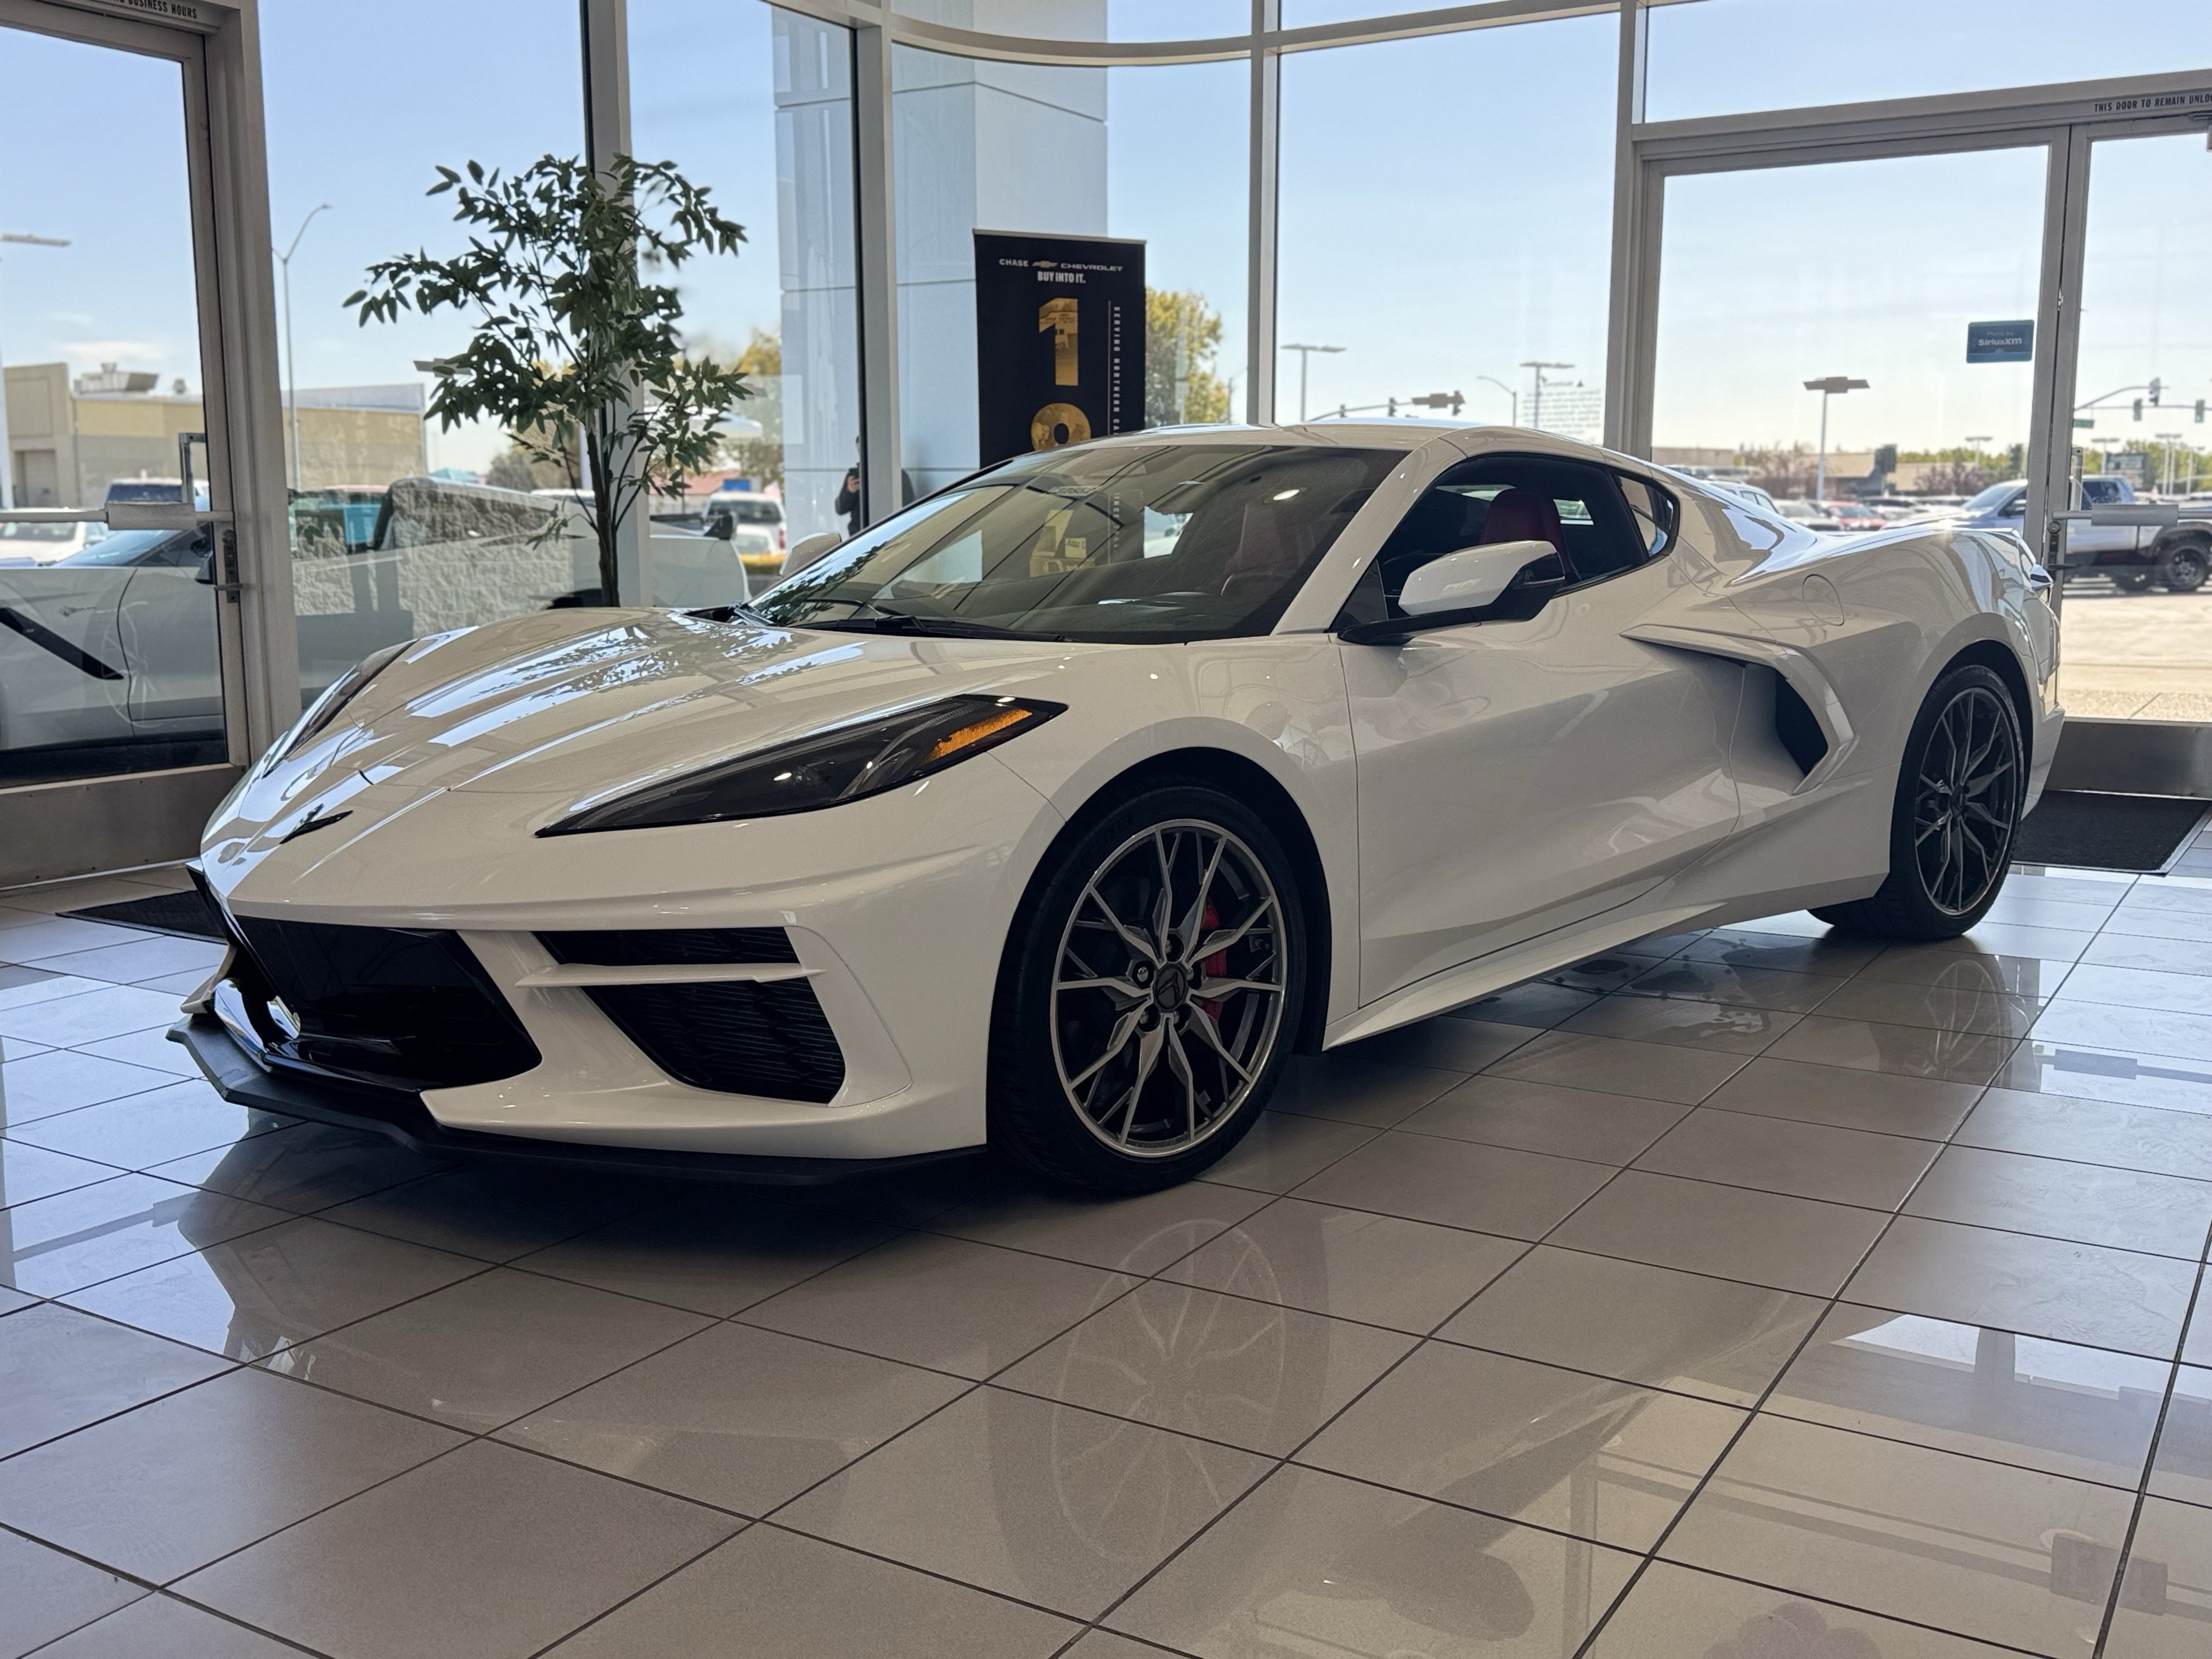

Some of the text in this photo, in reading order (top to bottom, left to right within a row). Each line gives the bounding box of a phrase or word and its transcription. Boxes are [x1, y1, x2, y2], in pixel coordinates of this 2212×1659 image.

[171, 4, 198, 19] HOURS
[2094, 103, 2112, 112] THIS
[2116, 100, 2137, 110] DOOR
[2141, 99, 2151, 108] TO
[2154, 96, 2186, 107] REMAIN
[998, 258, 1124, 272] CHASE CHEVROLET
[1037, 271, 1086, 283] BUY INTO IT.
